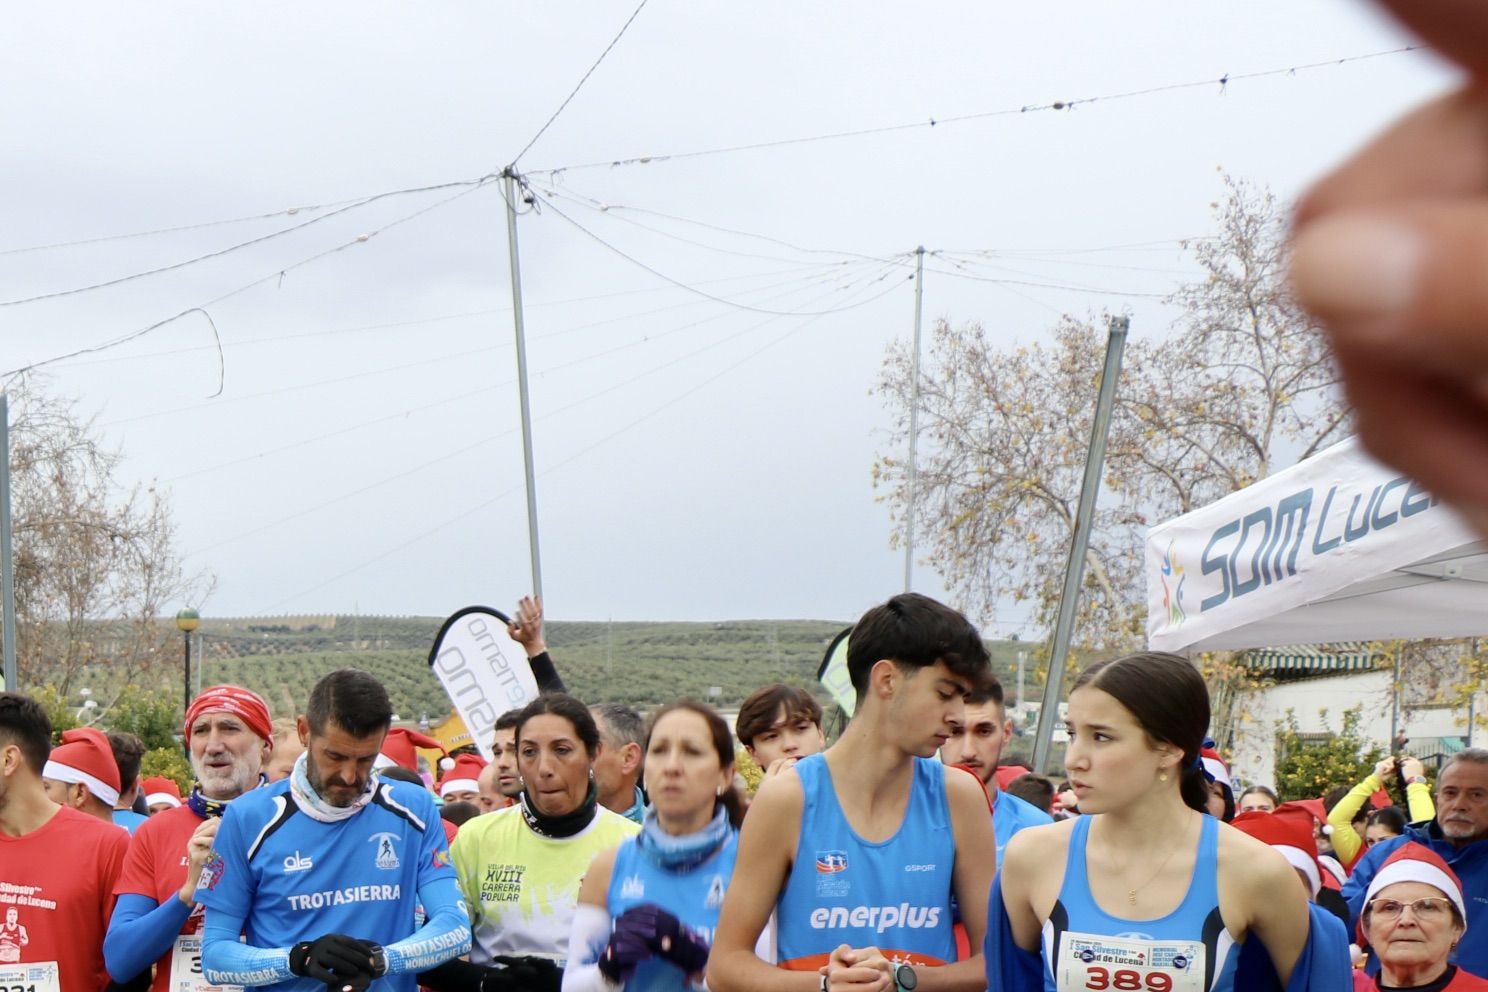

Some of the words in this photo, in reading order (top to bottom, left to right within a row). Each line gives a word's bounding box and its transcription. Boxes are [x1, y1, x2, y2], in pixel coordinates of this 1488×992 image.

[486, 870, 523, 883] XVIII
[482, 883, 520, 892] CARRERA
[17, 895, 28, 905] de
[288, 885, 401, 911] TROTASIERRA
[481, 892, 519, 902] POPULAR
[810, 902, 943, 933] enerplus
[400, 925, 470, 957] TROTASIERRA
[1115, 956, 1143, 965] Lucena
[207, 967, 280, 983] TROTASIERRA
